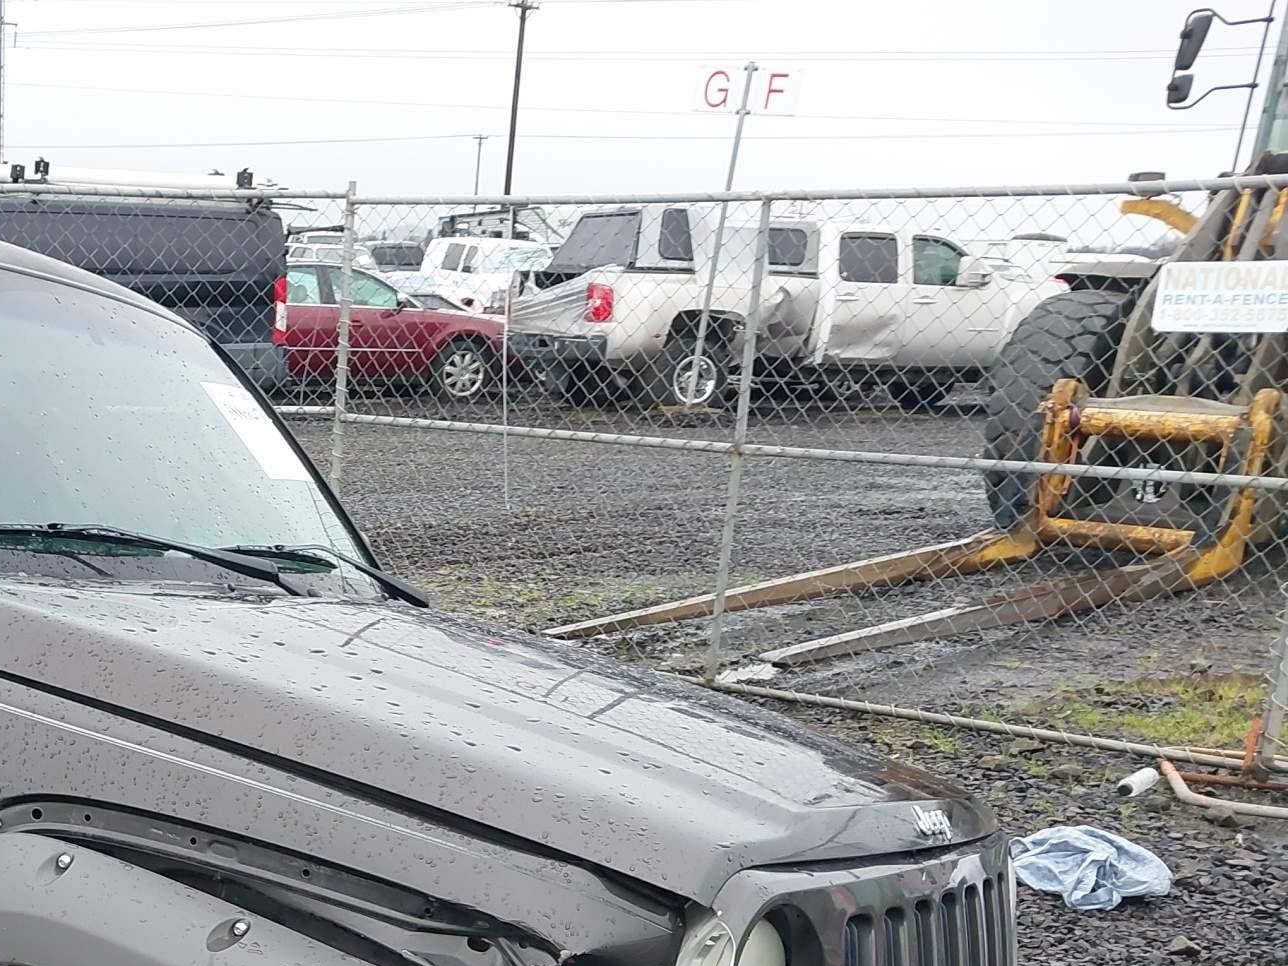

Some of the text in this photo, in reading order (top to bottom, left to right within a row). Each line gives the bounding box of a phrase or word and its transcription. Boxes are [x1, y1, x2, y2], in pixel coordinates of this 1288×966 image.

[704, 70, 730, 107] G
[764, 73, 789, 109] F
[1161, 293, 1288, 305] RENT-A-FENCE
